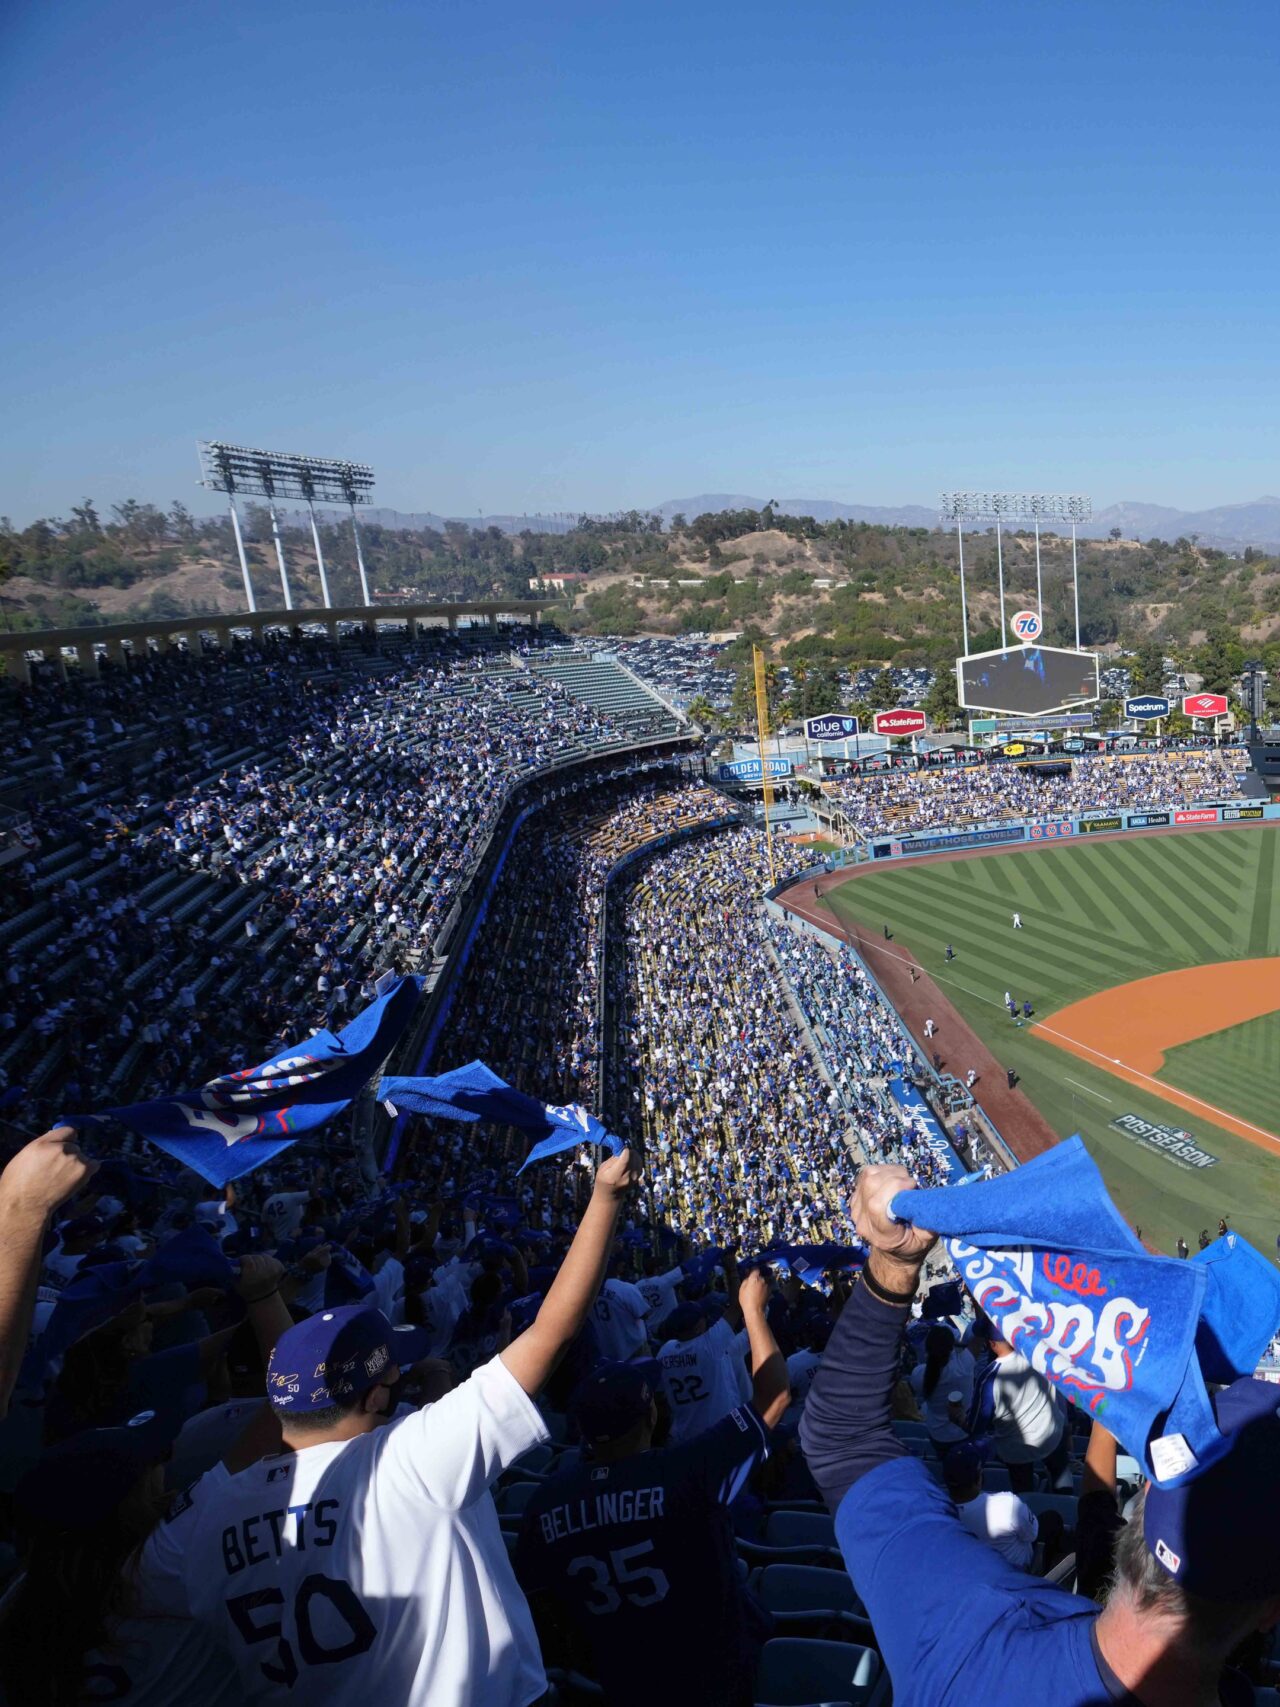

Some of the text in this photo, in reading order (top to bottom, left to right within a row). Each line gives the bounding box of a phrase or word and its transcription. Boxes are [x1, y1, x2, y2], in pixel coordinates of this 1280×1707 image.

[1017, 617, 1038, 634] 76
[1128, 703, 1165, 713] Spectrum
[811, 720, 840, 733] blue
[723, 761, 760, 778] GOLDEN
[764, 761, 787, 772] ROAD
[1148, 817, 1166, 825] Health
[905, 839, 937, 849] WAVE
[939, 835, 975, 845] THOSE
[1115, 1114, 1217, 1168] POSTSEASON
[267, 1201, 285, 1217] 42
[658, 1353, 698, 1370] KERSHAW
[287, 1384, 300, 1393] 50
[668, 1374, 710, 1406] 22
[272, 1394, 294, 1406] Dodgers
[540, 1486, 664, 1545] BELLINGER
[222, 1499, 339, 1575] BETTS
[566, 1538, 670, 1616] 35
[225, 1573, 378, 1690] 50
